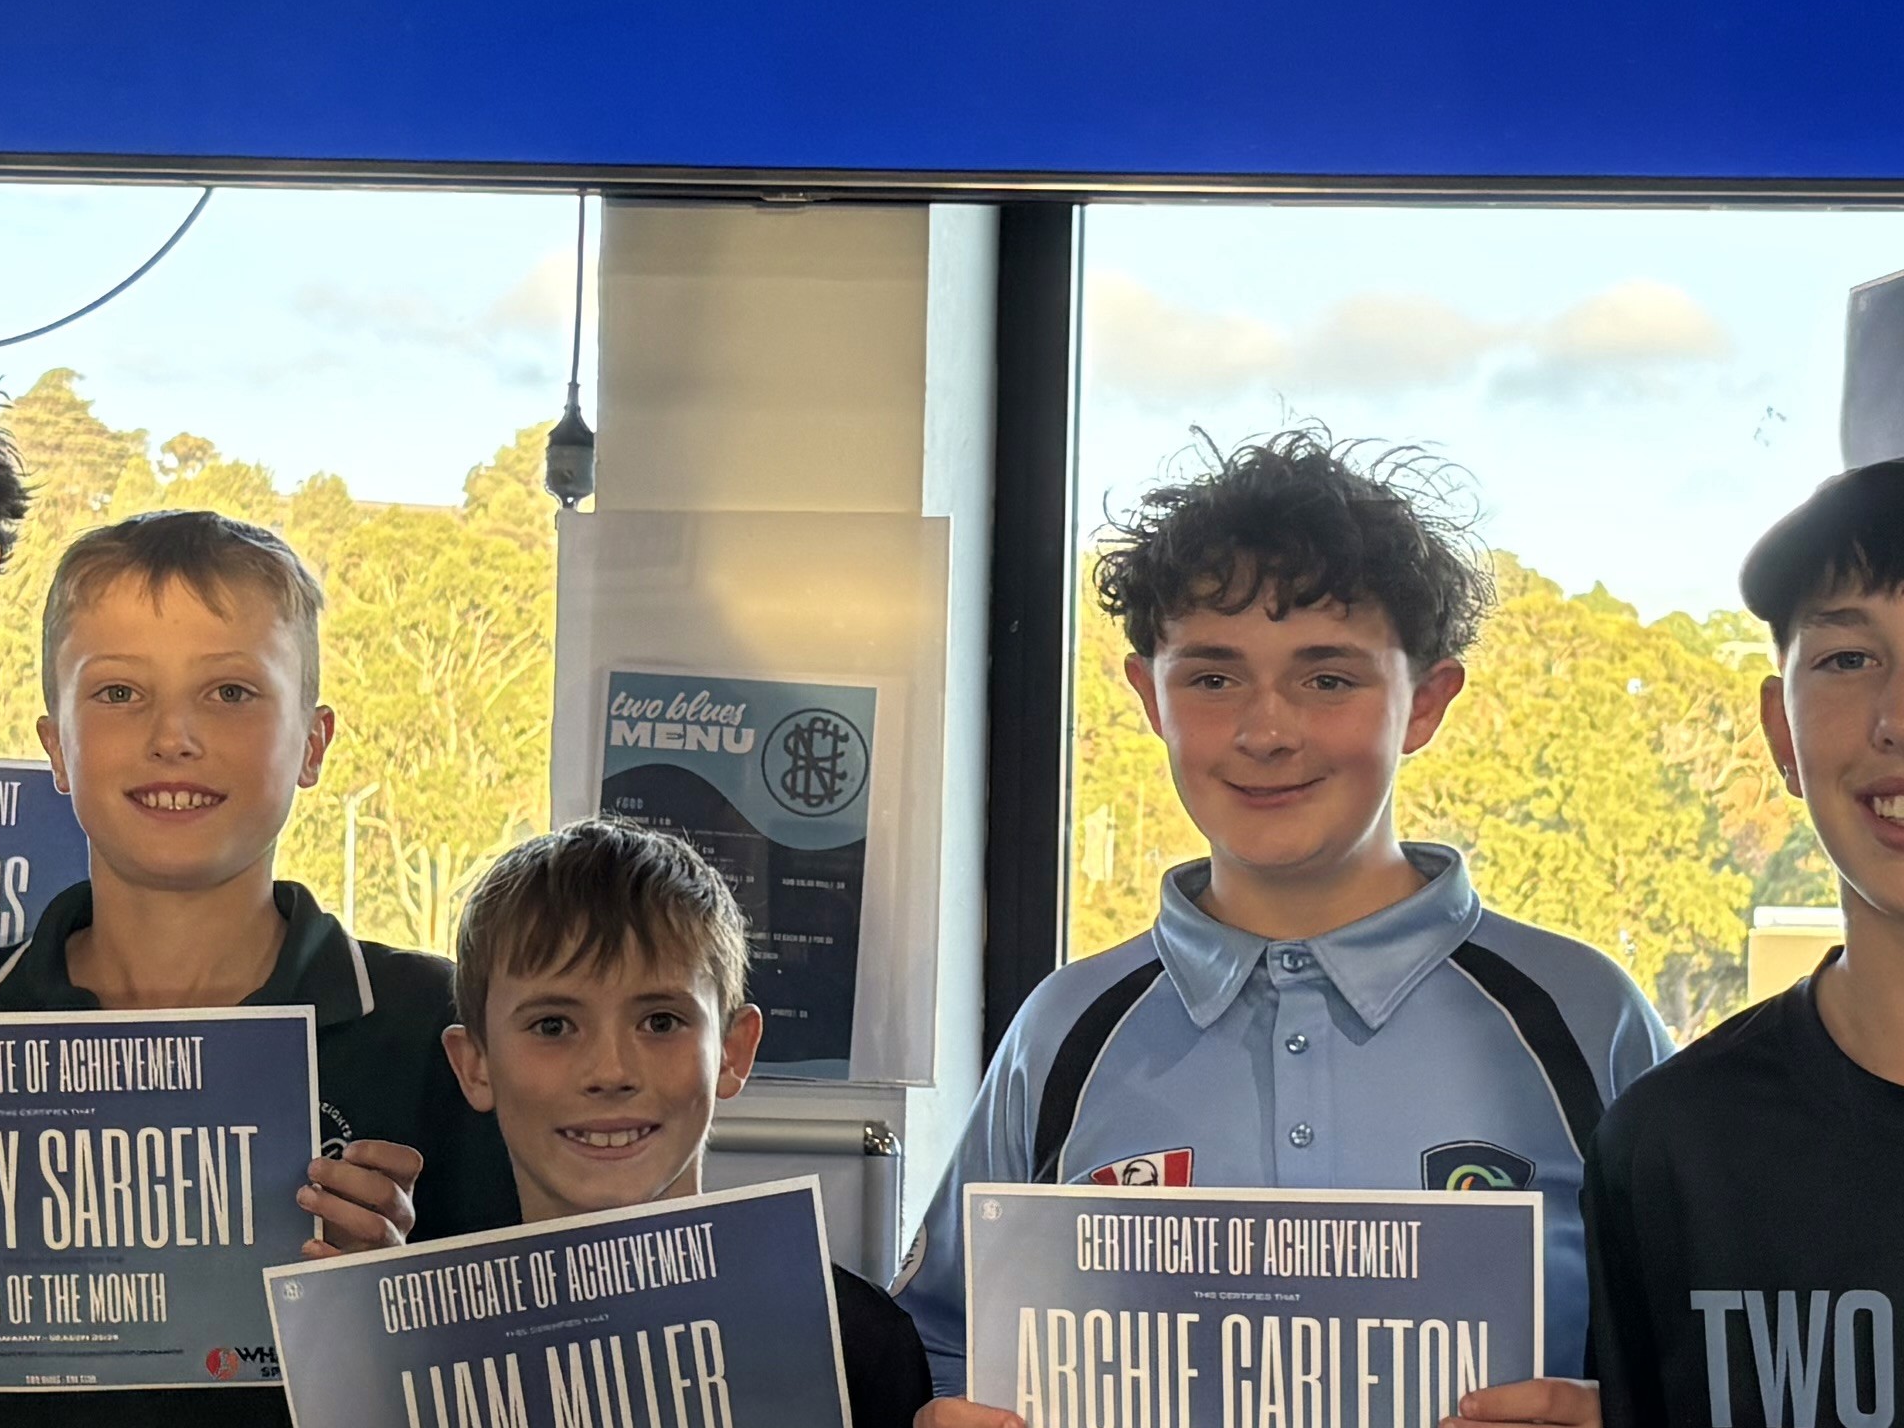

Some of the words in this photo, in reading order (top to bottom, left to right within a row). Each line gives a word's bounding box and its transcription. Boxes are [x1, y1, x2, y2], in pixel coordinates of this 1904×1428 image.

[610, 719, 756, 755] MENU
[611, 690, 664, 720] two
[664, 690, 747, 727] blues
[25, 1039, 50, 1094] OF
[58, 1036, 204, 1093] ACHIEVEMENT
[38, 1125, 259, 1251] SARGENT
[1076, 1213, 1220, 1275] CERTIFICATE
[1227, 1217, 1256, 1276] OF
[1263, 1219, 1422, 1279] ACHIEVEMENT
[379, 1255, 524, 1335] CERTIFICATE
[528, 1247, 558, 1310] OF
[565, 1222, 718, 1303] ACHIEVEMENT
